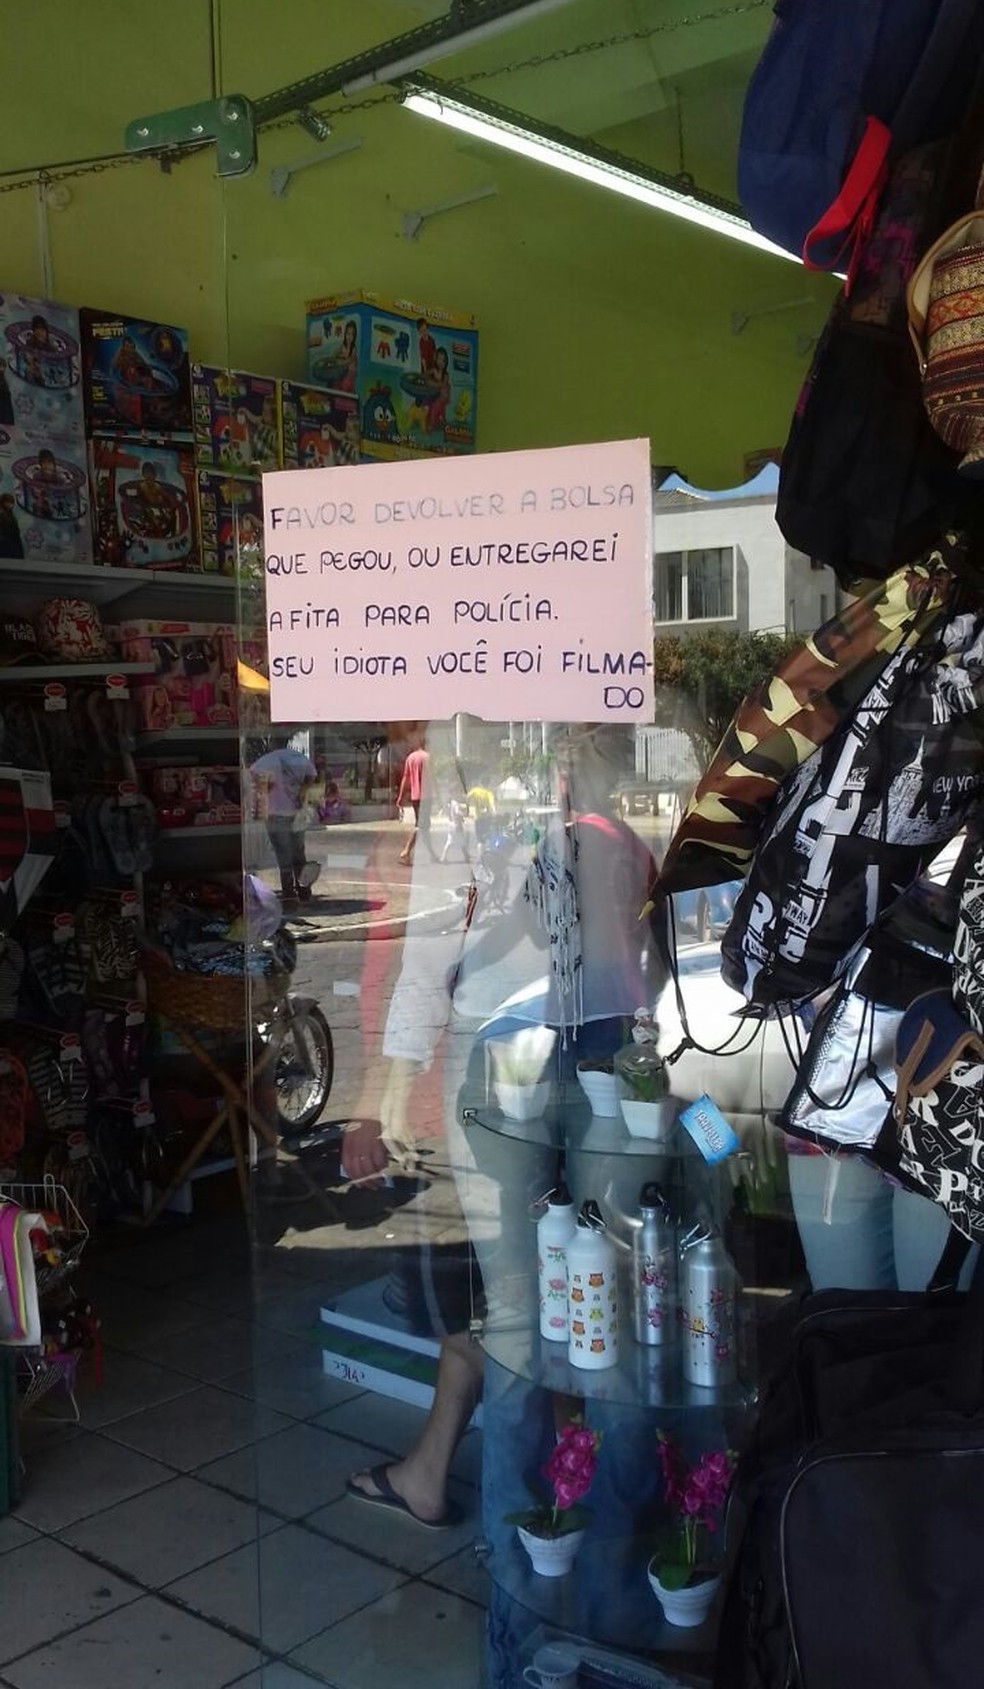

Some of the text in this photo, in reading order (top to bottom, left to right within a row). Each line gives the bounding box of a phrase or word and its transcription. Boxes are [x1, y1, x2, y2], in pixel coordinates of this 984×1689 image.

[271, 484, 634, 530] FAVOR DEVOLVER A BOLSA
[266, 553, 307, 576] QUE
[319, 550, 397, 574] PEGOU,
[408, 546, 441, 569] OU
[269, 611, 283, 632] A
[364, 603, 430, 628] PARA
[272, 654, 314, 678] SEU
[427, 639, 489, 676] VOCÊ
[602, 686, 645, 709] DO
